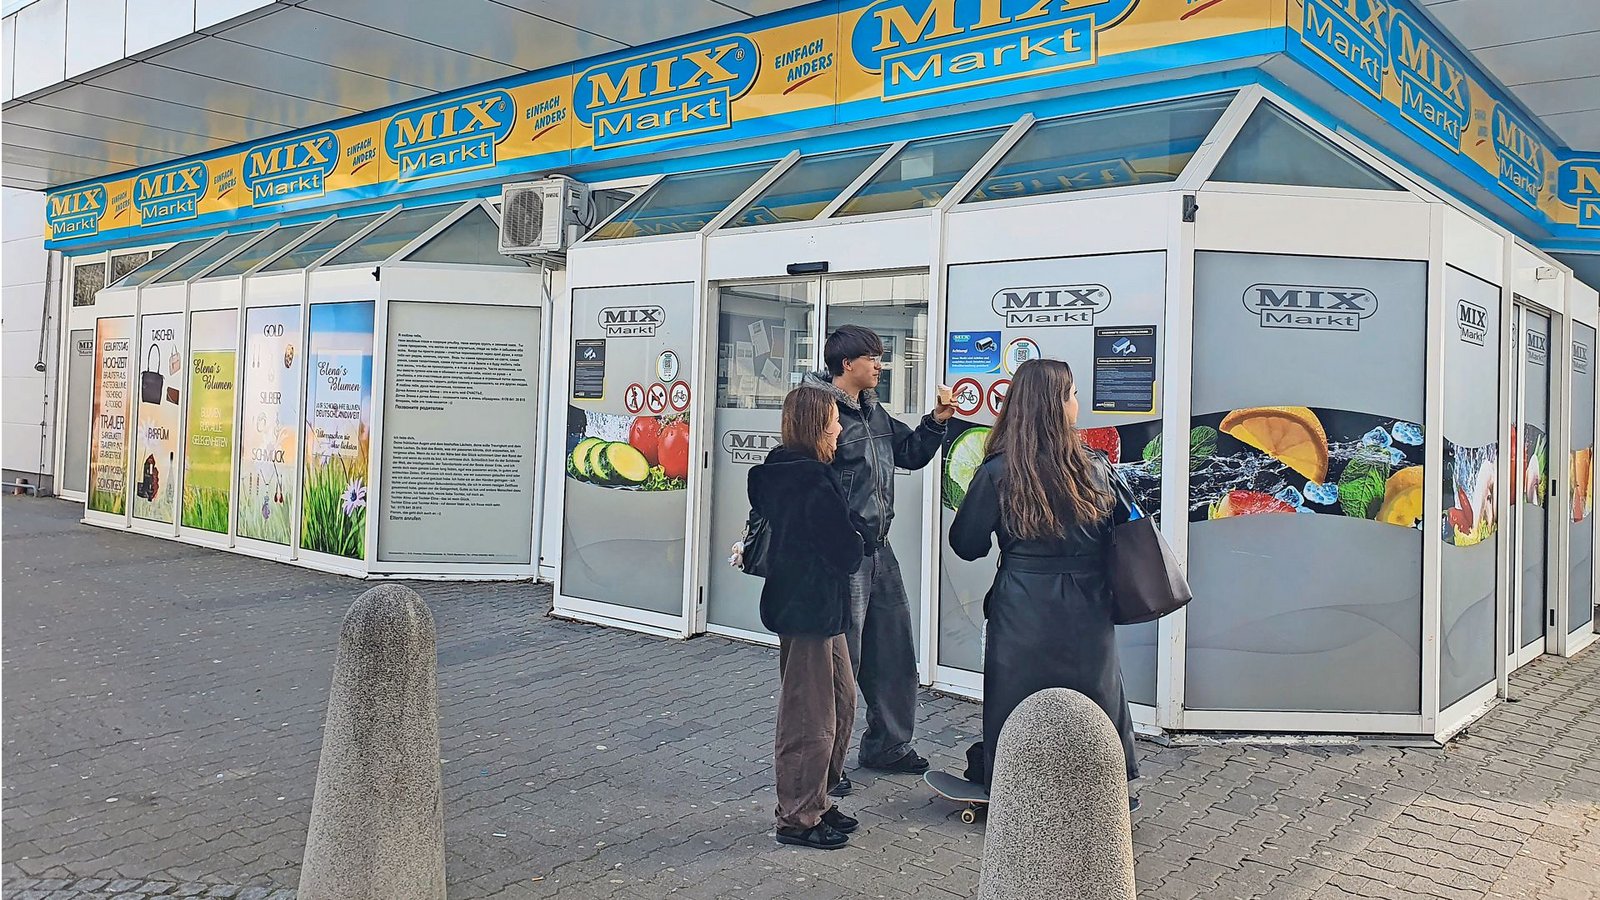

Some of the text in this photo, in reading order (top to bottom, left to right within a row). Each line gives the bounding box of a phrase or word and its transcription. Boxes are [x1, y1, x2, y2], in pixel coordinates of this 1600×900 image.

[1307, 3, 1380, 83] Markt
[775, 38, 824, 69] EINFACH
[891, 27, 1084, 85] Markt
[786, 53, 834, 82] ANDERS
[1398, 20, 1466, 111] MIX
[526, 95, 560, 120] EINFACH
[1404, 82, 1460, 140] Markt
[534, 107, 567, 131] ANDERS
[598, 97, 722, 137] Markt
[346, 137, 372, 157] EINFACH
[1497, 110, 1542, 174] MIX
[353, 147, 376, 167] ANDERS
[402, 141, 489, 172] Markt
[213, 168, 233, 184] EINFACH
[218, 177, 237, 193] ANDERS
[1500, 158, 1538, 198] Markt
[255, 174, 320, 199] Markt
[142, 198, 194, 220] Markt
[54, 217, 96, 235] Markt
[1010, 312, 1090, 324] Markt
[1266, 312, 1354, 327] Markt
[1460, 304, 1486, 329] MIX
[151, 329, 175, 341] TASCHEN
[263, 324, 284, 338] GOLD
[608, 326, 653, 335] Markt
[1461, 327, 1483, 342] Markt
[103, 342, 129, 352] GEBURTSTAG
[1527, 332, 1546, 351] MIX
[1573, 343, 1588, 361] MIX
[103, 356, 128, 369] HOCHZEIT
[202, 374, 234, 391] Blumen
[328, 376, 360, 392] Blumen
[260, 391, 282, 405] SILBER
[101, 414, 125, 430] TRAUER
[315, 409, 360, 420] DEUTSCHLANDWEIT
[147, 426, 169, 441] PARFÜM
[252, 447, 285, 463] SCHMUCK
[97, 478, 123, 491] SONSTIGES
